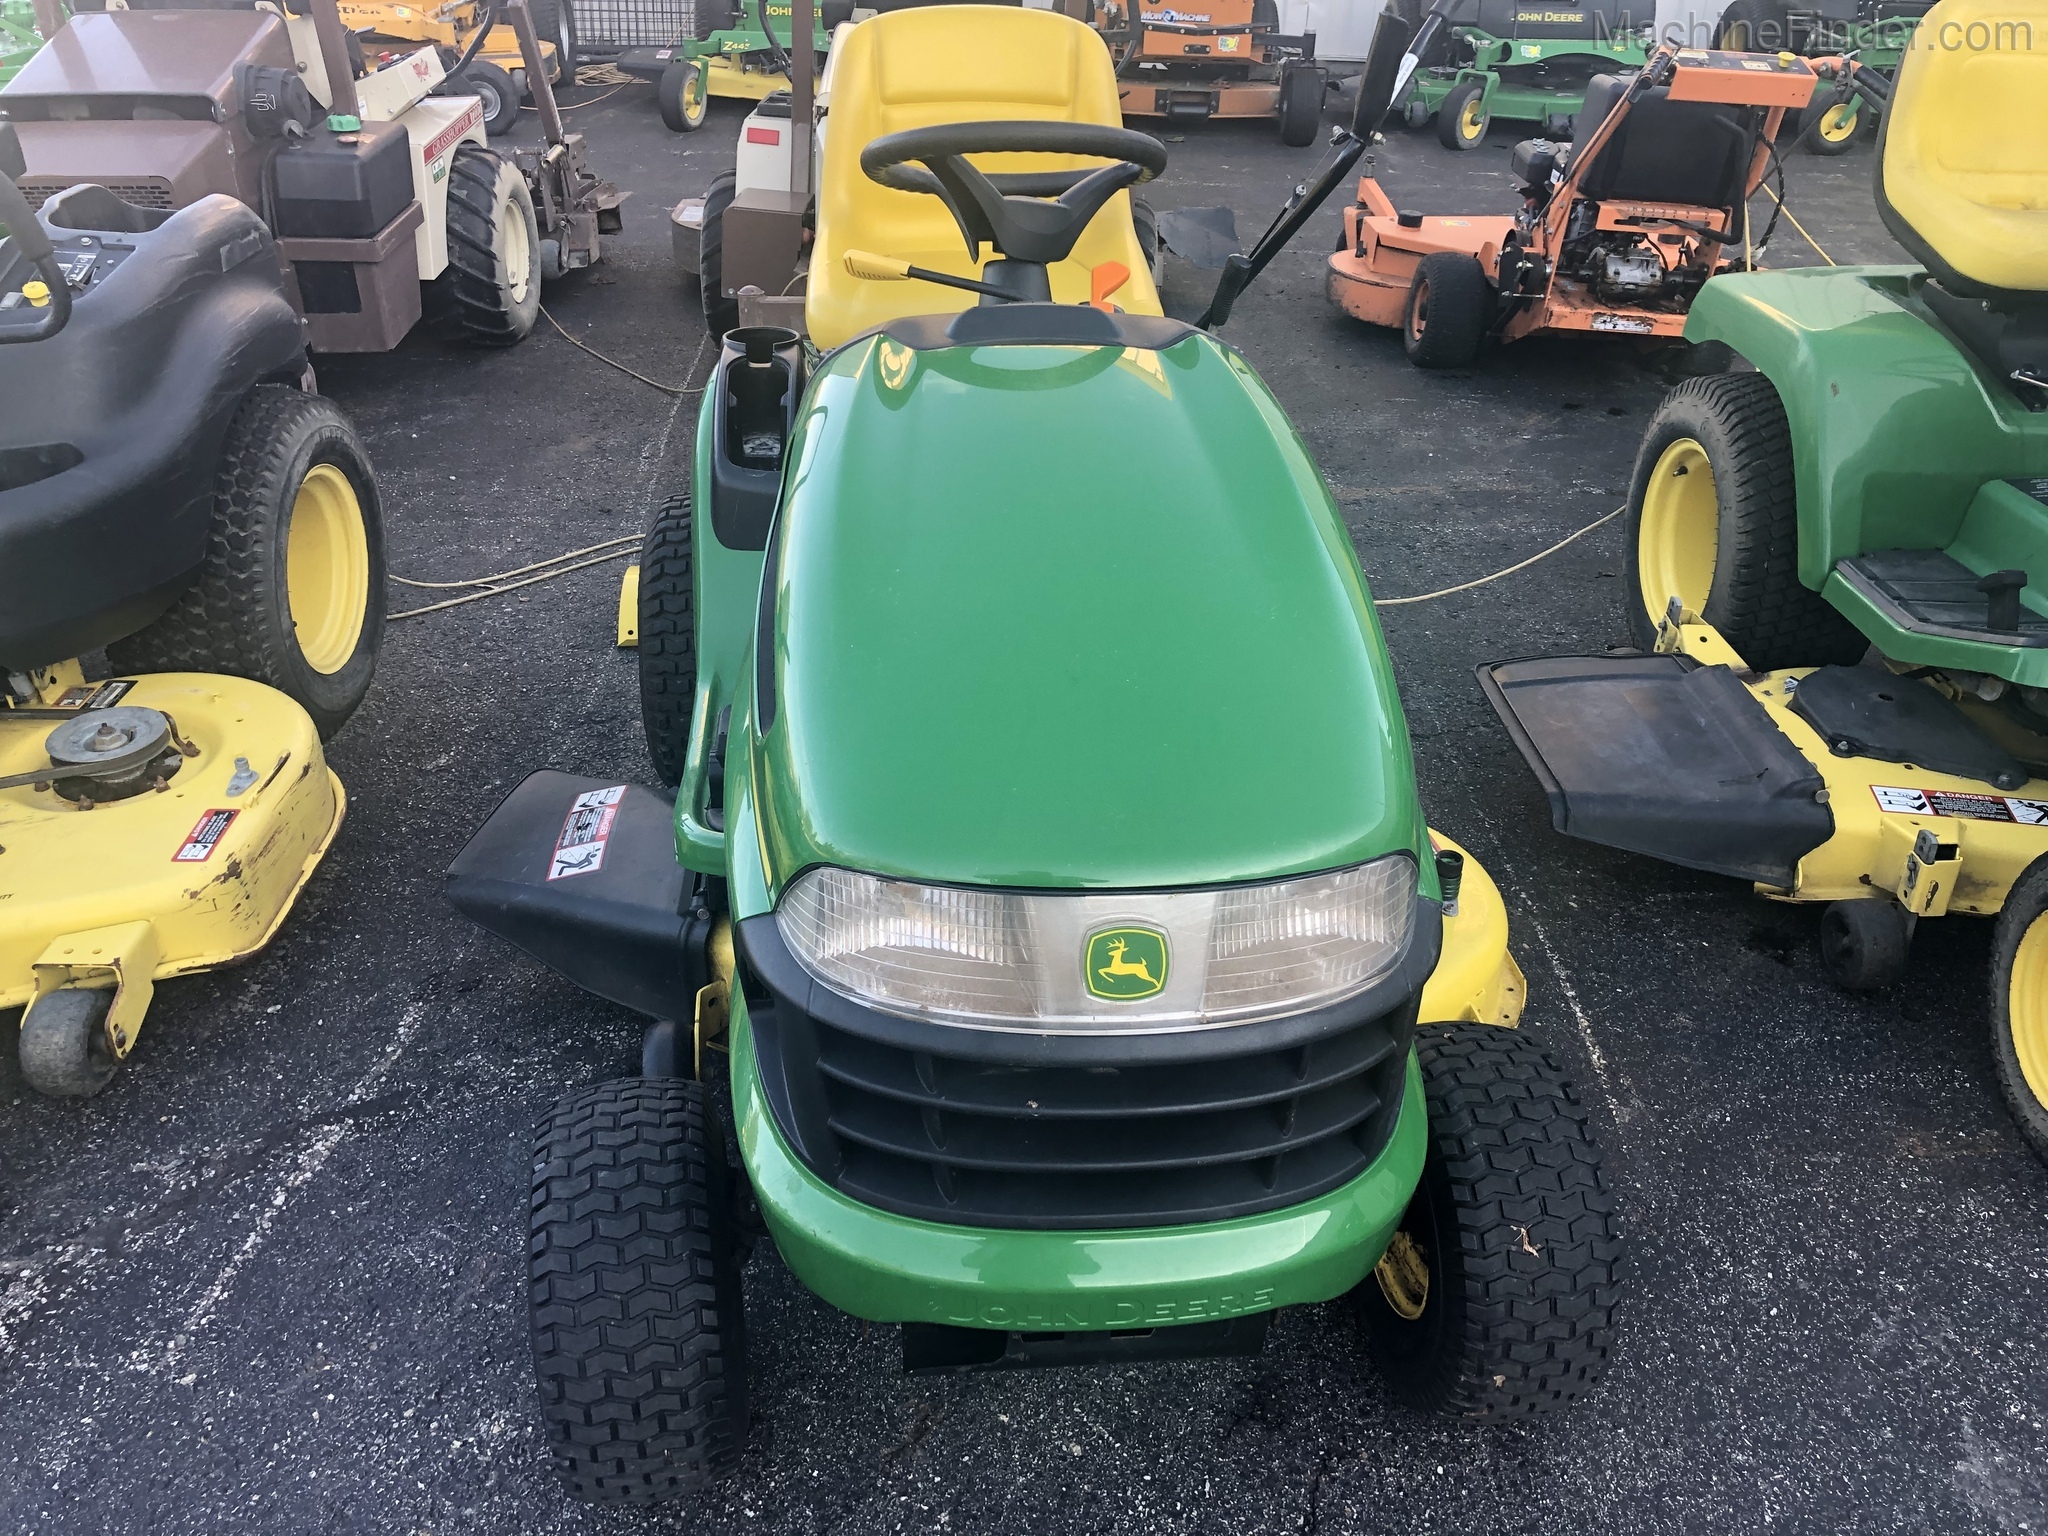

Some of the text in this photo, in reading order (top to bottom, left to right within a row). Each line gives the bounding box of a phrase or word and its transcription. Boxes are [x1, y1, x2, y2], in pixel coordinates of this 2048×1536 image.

[1510, 12, 1584, 23] OHN DEERE
[1946, 792, 1994, 801] DANGER
[947, 1287, 1274, 1326] JOHN DEERE
